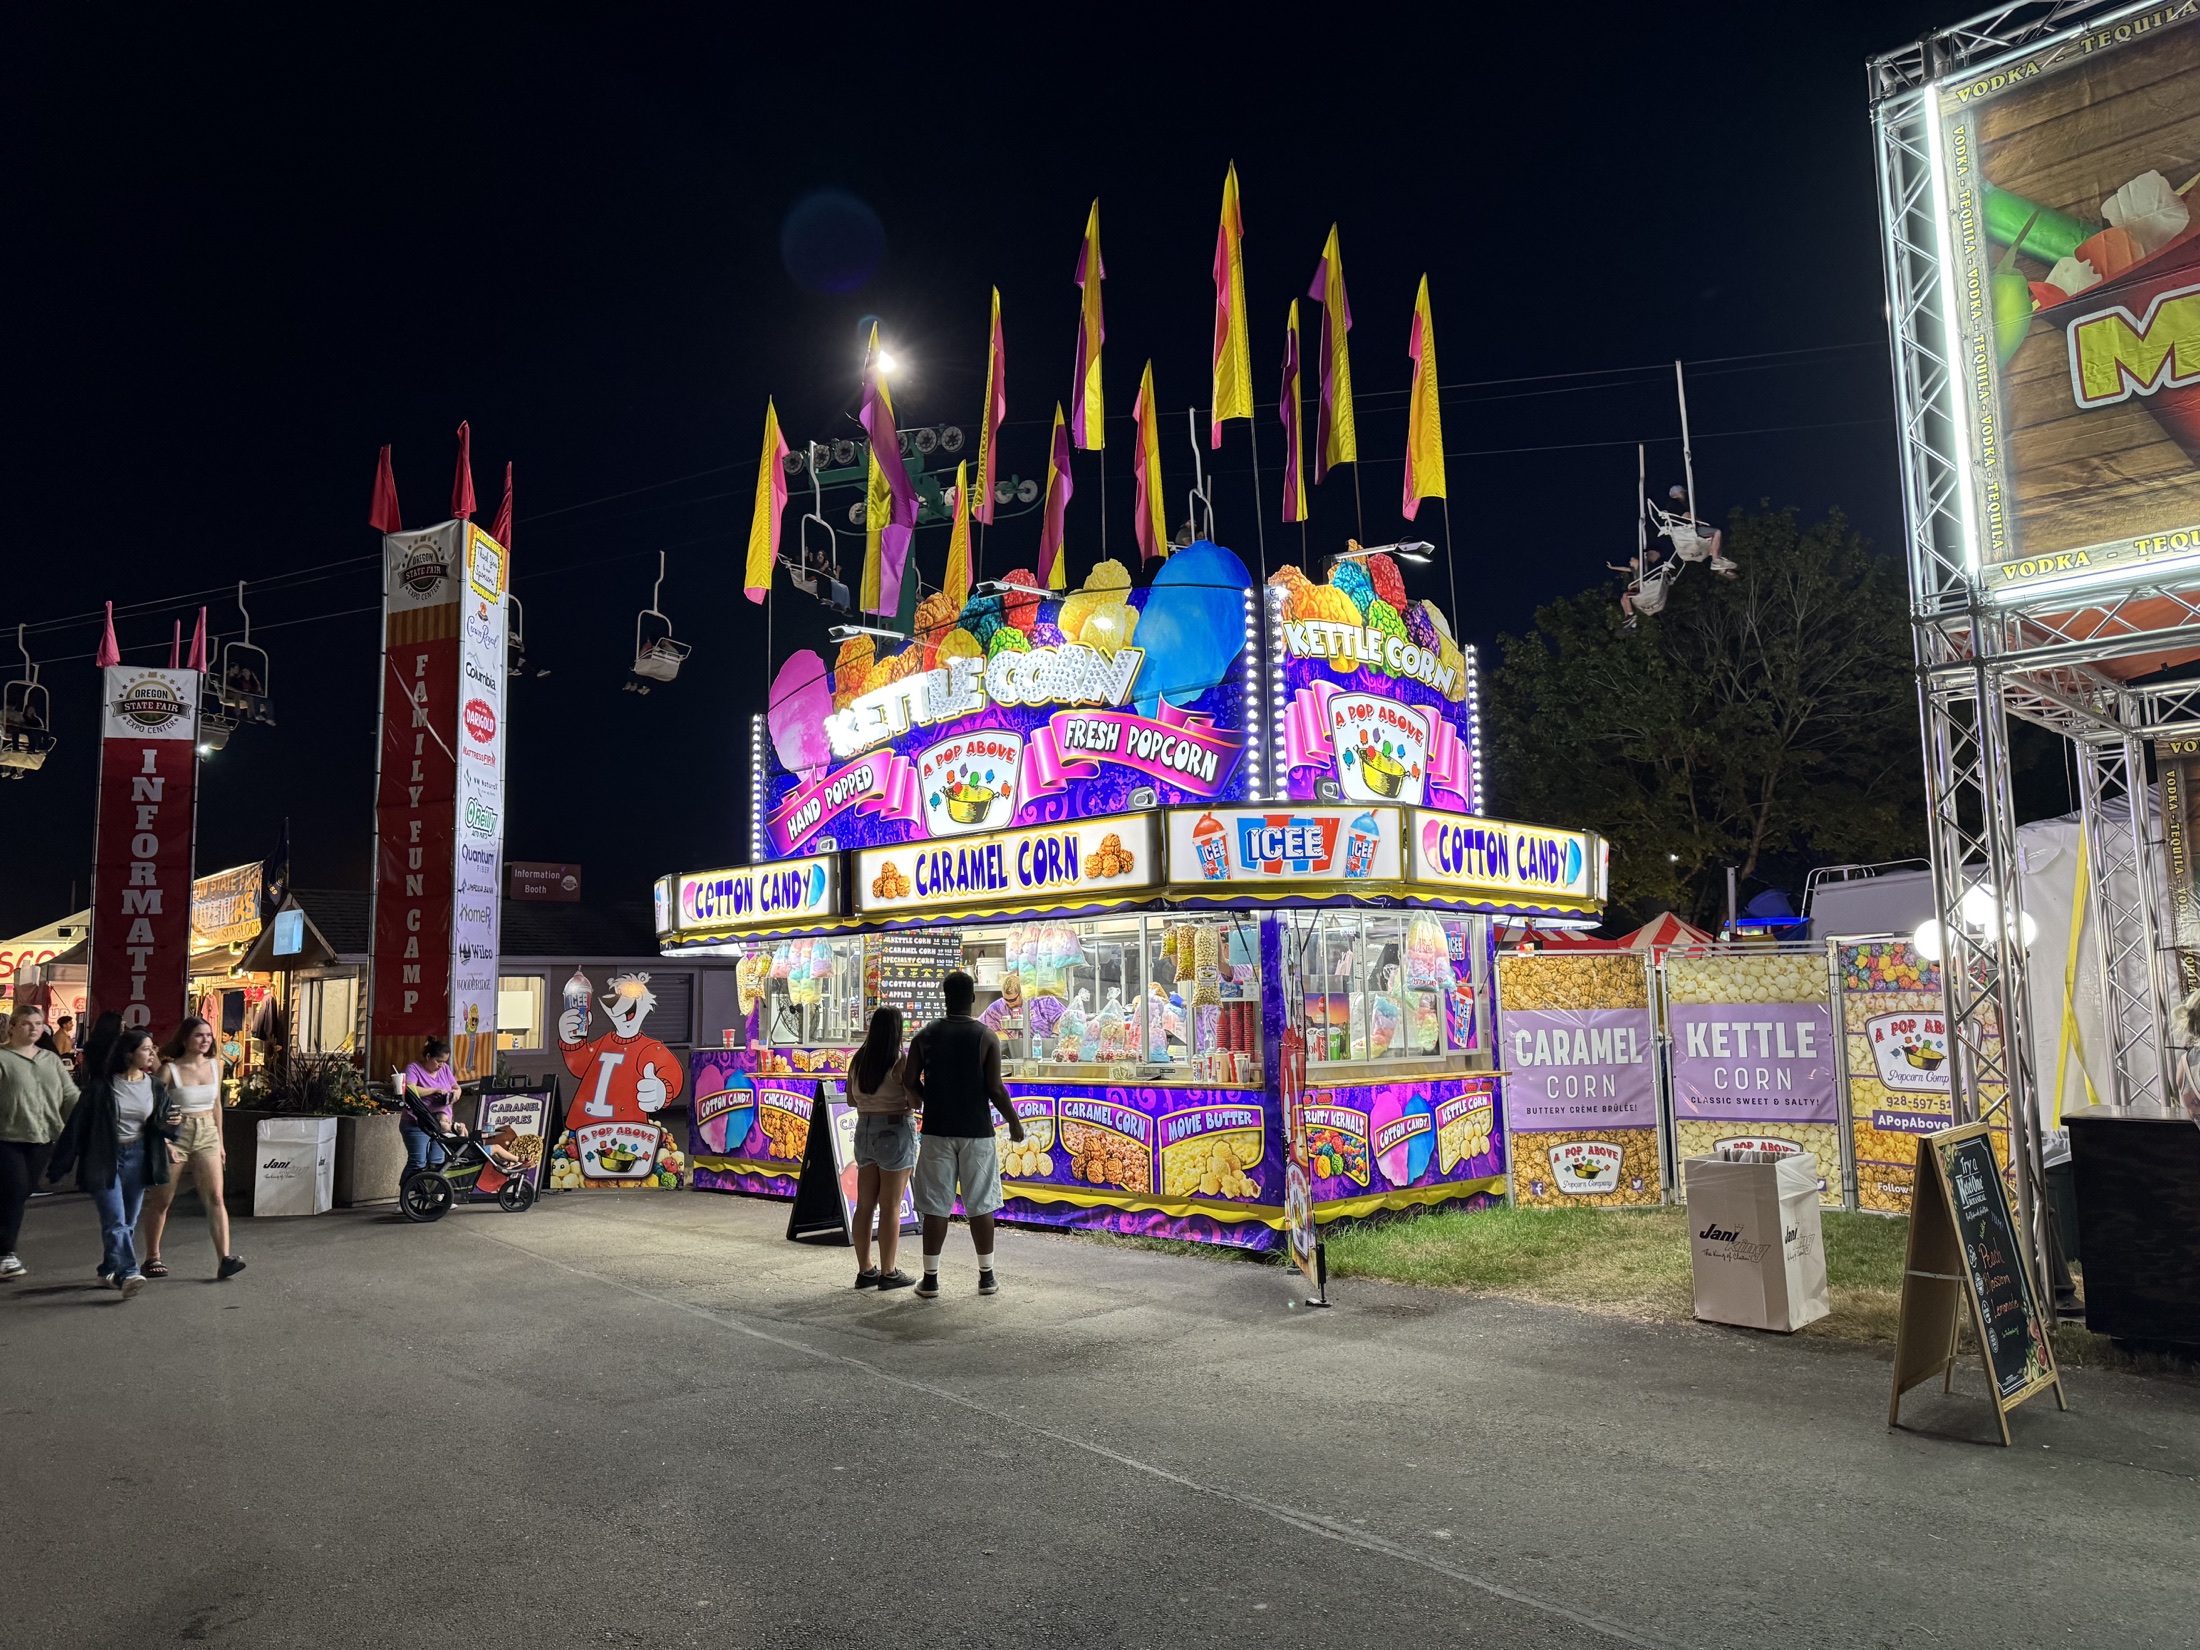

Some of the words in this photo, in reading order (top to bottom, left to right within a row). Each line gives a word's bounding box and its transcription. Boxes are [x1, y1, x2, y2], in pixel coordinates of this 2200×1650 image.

[1956, 61, 2041, 104] VODKA
[2080, 2, 2199, 54] TEQUILA
[1952, 124, 1969, 176] VODKA
[1957, 189, 1977, 263] TEQUILA
[1966, 268, 1983, 321] VODKA
[1972, 334, 1990, 401] TEQUILA
[1980, 415, 1996, 468] VODKA
[1987, 482, 2004, 551] TEQUILA
[412, 552, 433, 566] OREGON
[2002, 551, 2092, 580] VODKA
[406, 566, 425, 580] STATE
[426, 565, 442, 574] FAIR
[408, 588, 420, 600] EXPO
[421, 583, 441, 600] CENTER
[1282, 621, 1383, 664] KETTLE
[1386, 639, 1457, 697] CORN
[465, 662, 496, 691] Columbia
[135, 689, 168, 699] OREGON
[823, 654, 986, 758] KETTLE
[985, 643, 1146, 707] CORN
[124, 701, 154, 711] STATE
[156, 702, 179, 713] FAIR
[126, 718, 145, 733] EXPO
[147, 720, 176, 734] CENTER
[408, 654, 429, 808] FAMILY
[466, 708, 494, 733] DARIGOLD
[1335, 712, 1345, 727] A
[1348, 705, 1374, 722] POP
[1378, 706, 1426, 746] ABOVE
[923, 763, 933, 777] A
[936, 746, 962, 766] POP
[966, 741, 1016, 762] ABOVE
[1063, 718, 1121, 752] FRESH
[1125, 723, 1220, 783] POPCORN
[786, 798, 821, 842] HAND
[824, 764, 874, 809] POPPED
[461, 843, 495, 865] Quantum
[1201, 841, 1226, 863] ICEE
[1246, 826, 1324, 862] ICEE
[1351, 840, 1374, 859] ICEE
[1438, 827, 1509, 878] COTTON
[1516, 836, 1569, 886] CANDY
[406, 820, 424, 897] FUN
[914, 842, 1007, 899] CARAMEL
[1015, 835, 1081, 886] CORN
[514, 869, 560, 880] Information
[120, 749, 165, 1036] INFORMATIO
[525, 884, 547, 893] Booth
[695, 876, 753, 919] COTTON
[760, 868, 812, 913] CANDY
[471, 943, 493, 960] Wilco
[888, 946, 918, 954] CARAMEL
[913, 937, 932, 945] CORN
[402, 909, 422, 1014] CAMP
[888, 980, 916, 988] COTTON
[916, 980, 941, 988] CANDY
[569, 993, 588, 1009] ICEE
[1686, 1021, 1818, 1059] KETTLE
[1875, 1028, 1884, 1043] A
[1891, 1018, 1917, 1036] POP
[1515, 1027, 1643, 1066] CARAMEL
[1547, 1074, 1617, 1099] CORN
[1714, 1067, 1793, 1091] CORN
[1887, 1069, 1924, 1082] Popcorn
[490, 1102, 540, 1113] CARAMEL
[701, 1094, 727, 1118] COTTON
[728, 1092, 751, 1106] CANDY
[764, 1092, 794, 1111] CHICAGO
[795, 1100, 814, 1120] STYL
[1017, 1103, 1047, 1118] CORN
[1441, 1102, 1467, 1125] KETTLE
[1468, 1096, 1488, 1110] CORN
[1526, 1106, 1566, 1115] BUTTERY
[1569, 1104, 1598, 1114] CRÈME
[1690, 1096, 1732, 1105] CLASSIC
[1736, 1097, 1769, 1106] SWEET
[1773, 1097, 1780, 1106] &
[1784, 1097, 1820, 1107] SALTY!
[495, 1115, 532, 1125] APPLES
[1065, 1102, 1113, 1127] CARAMEL
[1115, 1113, 1146, 1141] CORN
[1168, 1118, 1202, 1142] MOVIE
[1205, 1111, 1253, 1130] BUTTER
[1331, 1113, 1365, 1136] KERNALS
[580, 1134, 589, 1143] A
[591, 1127, 614, 1139] POP
[616, 1126, 656, 1142] ABOVE
[1379, 1125, 1405, 1149] COTTON
[1407, 1117, 1429, 1133] CANDY
[263, 1158, 291, 1169] Jani
[1553, 1153, 1560, 1164] A
[1565, 1145, 1583, 1159] POP
[1587, 1145, 1619, 1161] ABOVE
[1960, 1156, 1972, 1176] Try
[1973, 1157, 1979, 1171] a
[1563, 1180, 1587, 1191] Popcorn
[1587, 1179, 1613, 1189] Company
[1877, 1181, 1909, 1194] Follow
[1699, 1223, 1744, 1242] Jani
[1978, 1236, 2005, 1269] Peach
[1983, 1271, 2012, 1295] Blossom
[1990, 1292, 2020, 1319] Lemonade
